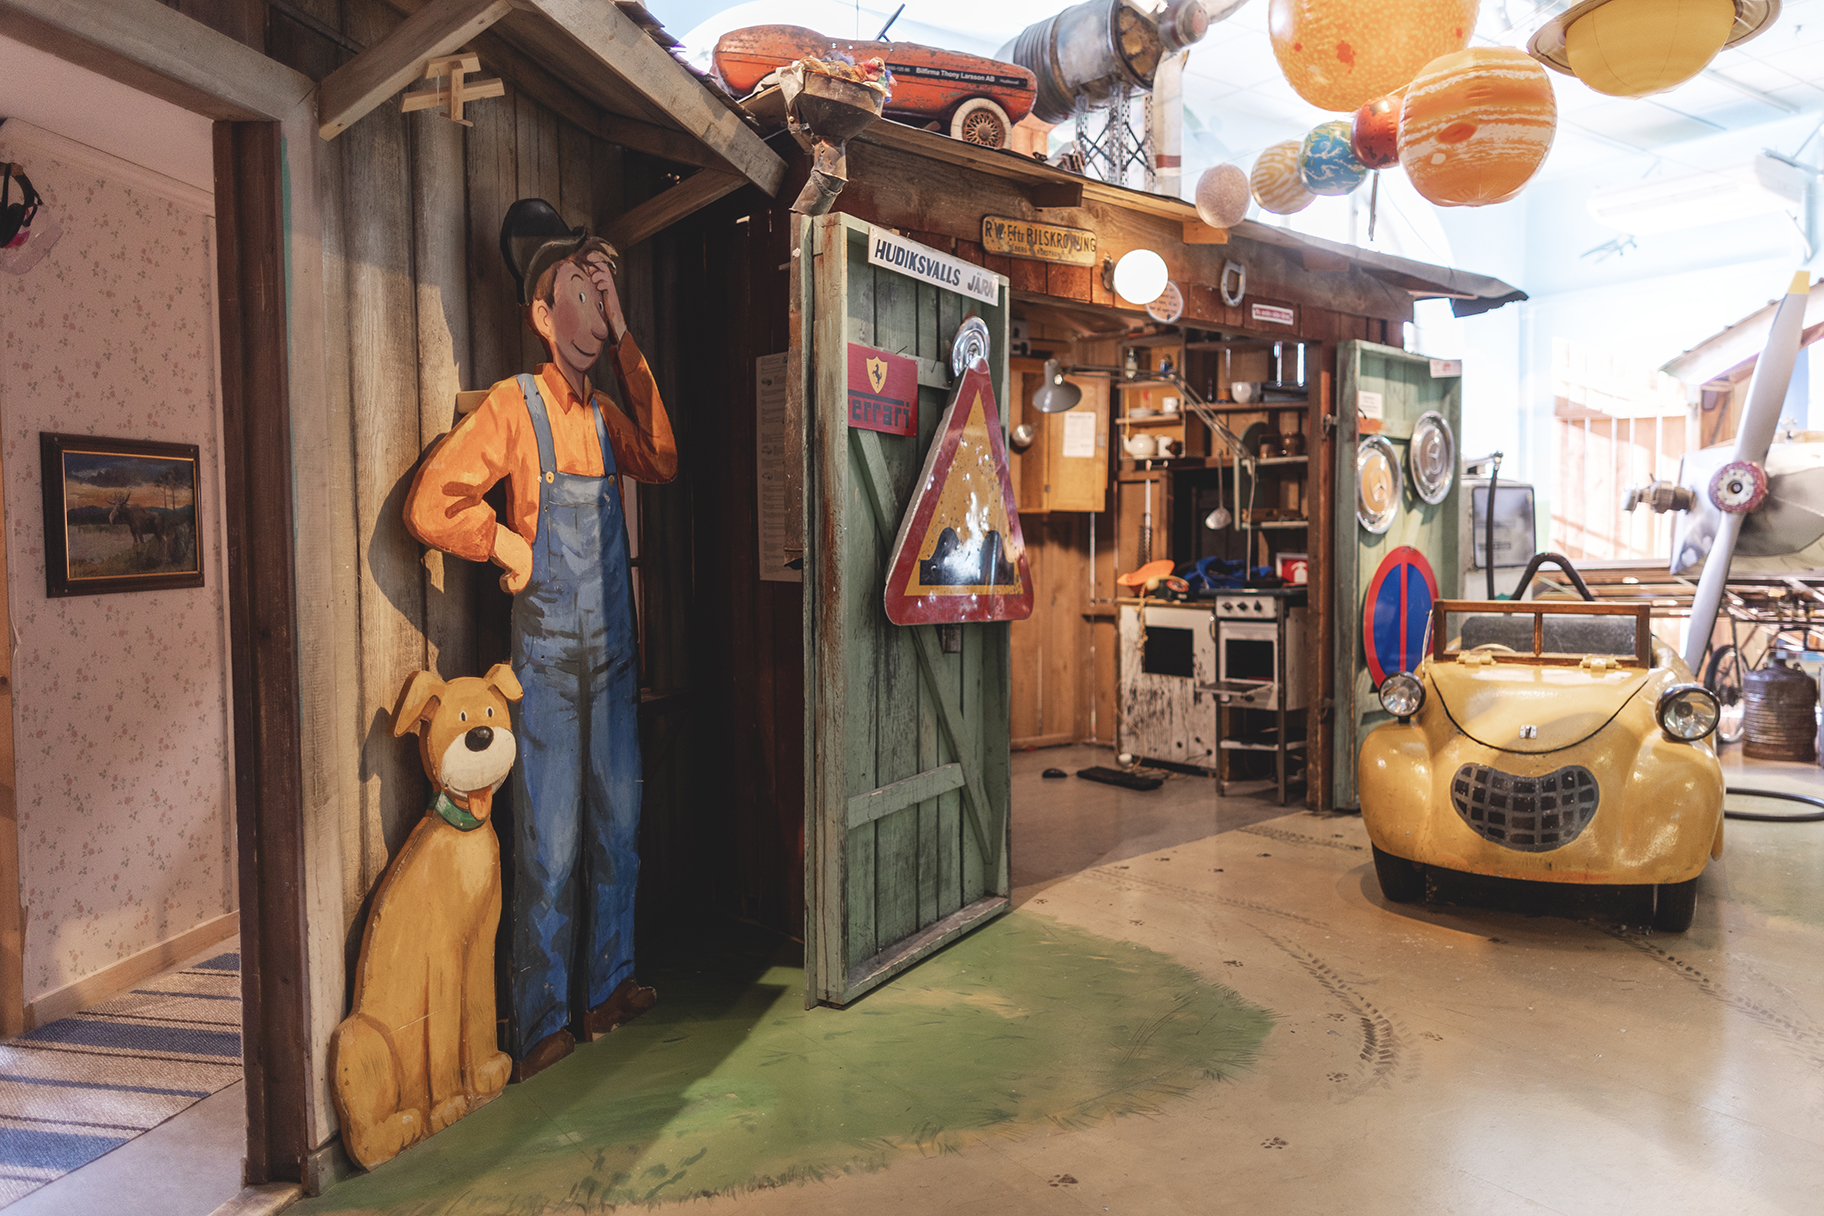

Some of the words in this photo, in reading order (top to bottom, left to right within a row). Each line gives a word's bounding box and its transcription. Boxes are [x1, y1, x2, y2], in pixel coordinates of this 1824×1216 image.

[916, 67, 940, 76] Bilfirma
[941, 69, 960, 80] Thony
[961, 72, 986, 81] Larsson
[986, 75, 996, 83] AB
[874, 238, 961, 287] HUDIKSVALLS
[967, 271, 996, 299] JÄRN
[848, 398, 910, 430] errari
